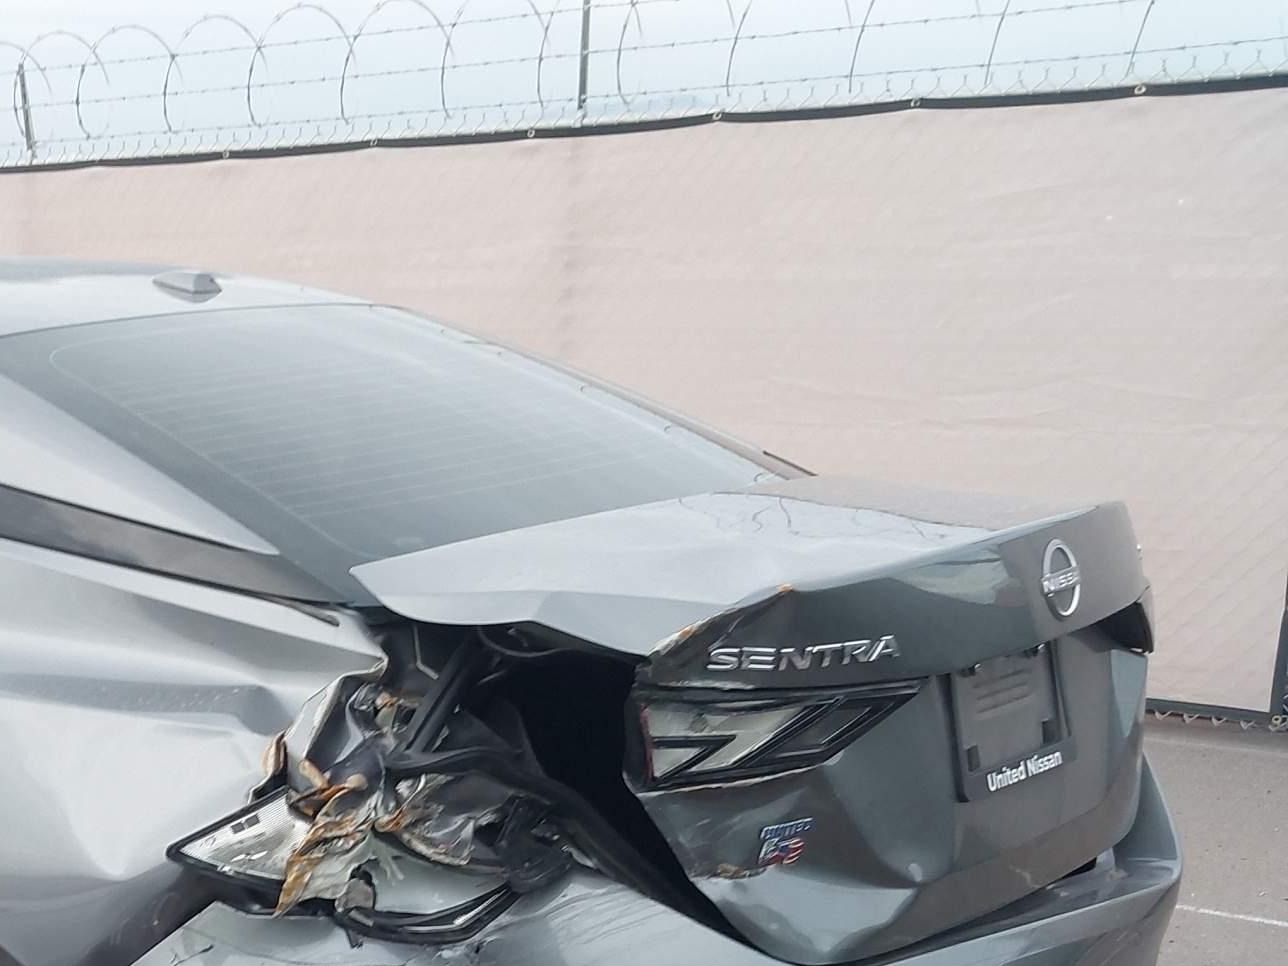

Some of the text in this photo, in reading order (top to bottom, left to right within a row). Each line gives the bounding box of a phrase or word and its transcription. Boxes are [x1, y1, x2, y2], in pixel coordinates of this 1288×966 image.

[706, 634, 900, 671] SENTRA
[986, 750, 1063, 793] United Nissan
